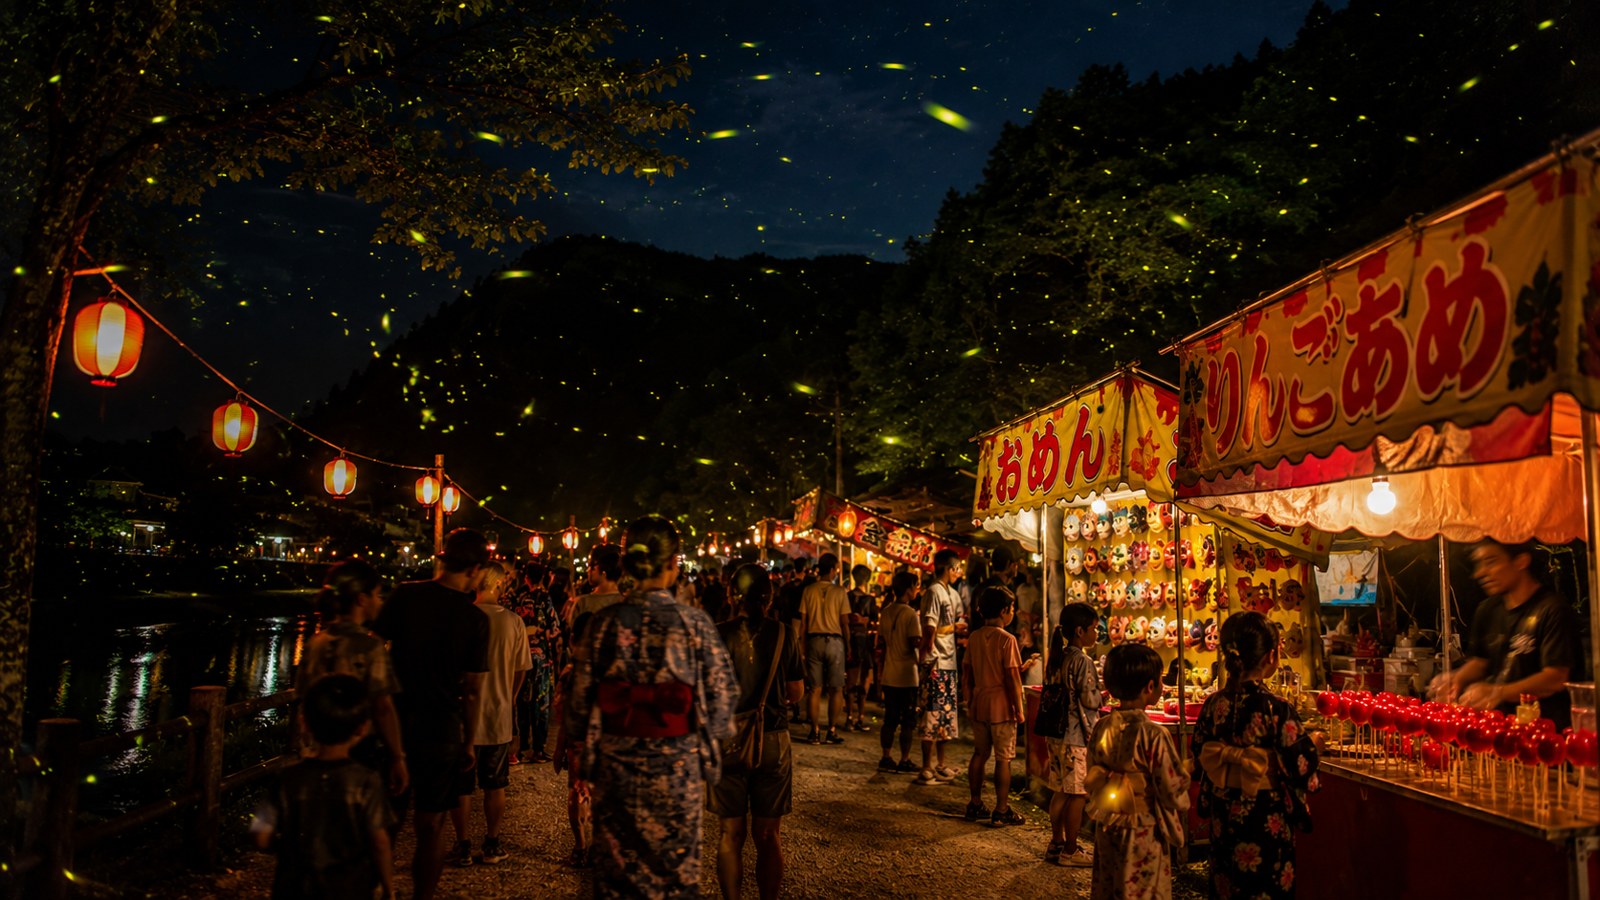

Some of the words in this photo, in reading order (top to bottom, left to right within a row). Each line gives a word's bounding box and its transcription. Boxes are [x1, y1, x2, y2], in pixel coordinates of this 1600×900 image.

[1205, 236, 1509, 459] りんごあめ
[996, 404, 1105, 504] おめん
